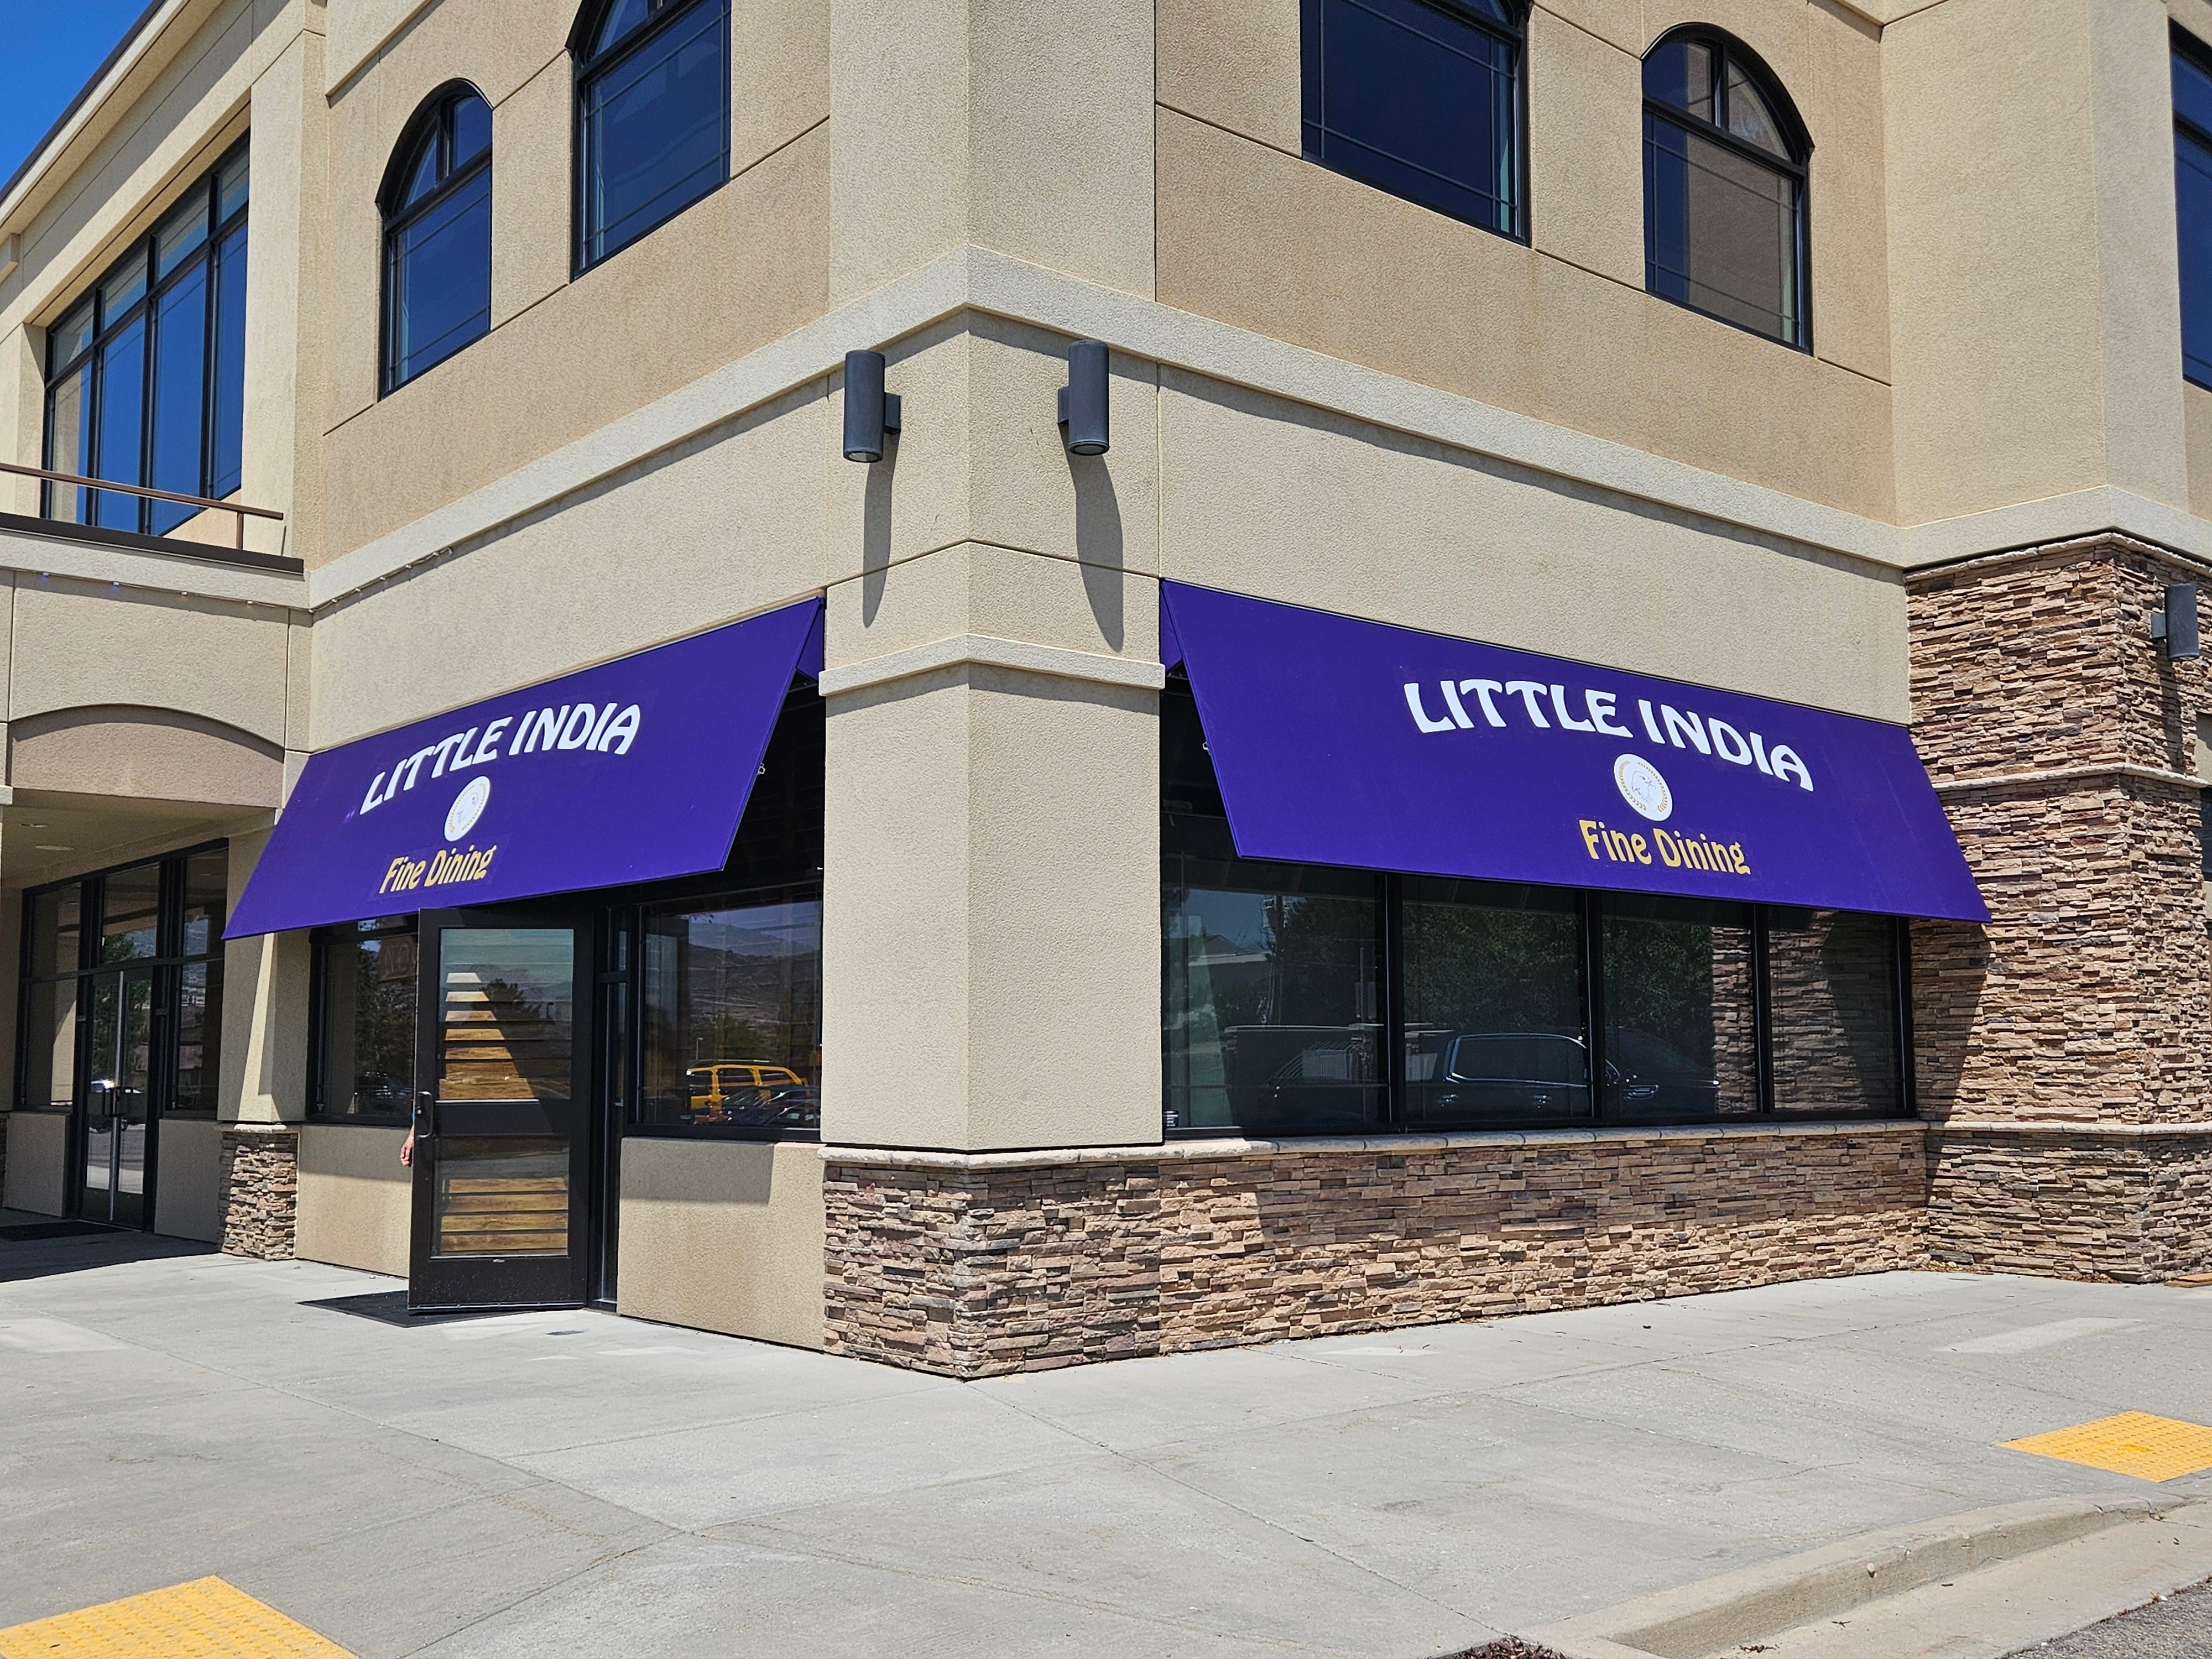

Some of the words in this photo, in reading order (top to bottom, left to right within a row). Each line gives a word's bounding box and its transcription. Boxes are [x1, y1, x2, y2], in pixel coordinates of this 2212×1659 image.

[359, 716, 513, 815] LITTLE
[508, 702, 641, 756] INDIA
[1404, 679, 1634, 738] LITTLE
[1638, 699, 1814, 792] INDIA
[379, 857, 426, 894] Fine
[424, 844, 497, 887] Dining
[1579, 820, 1652, 865] Fine
[1652, 828, 1751, 875] Dining
